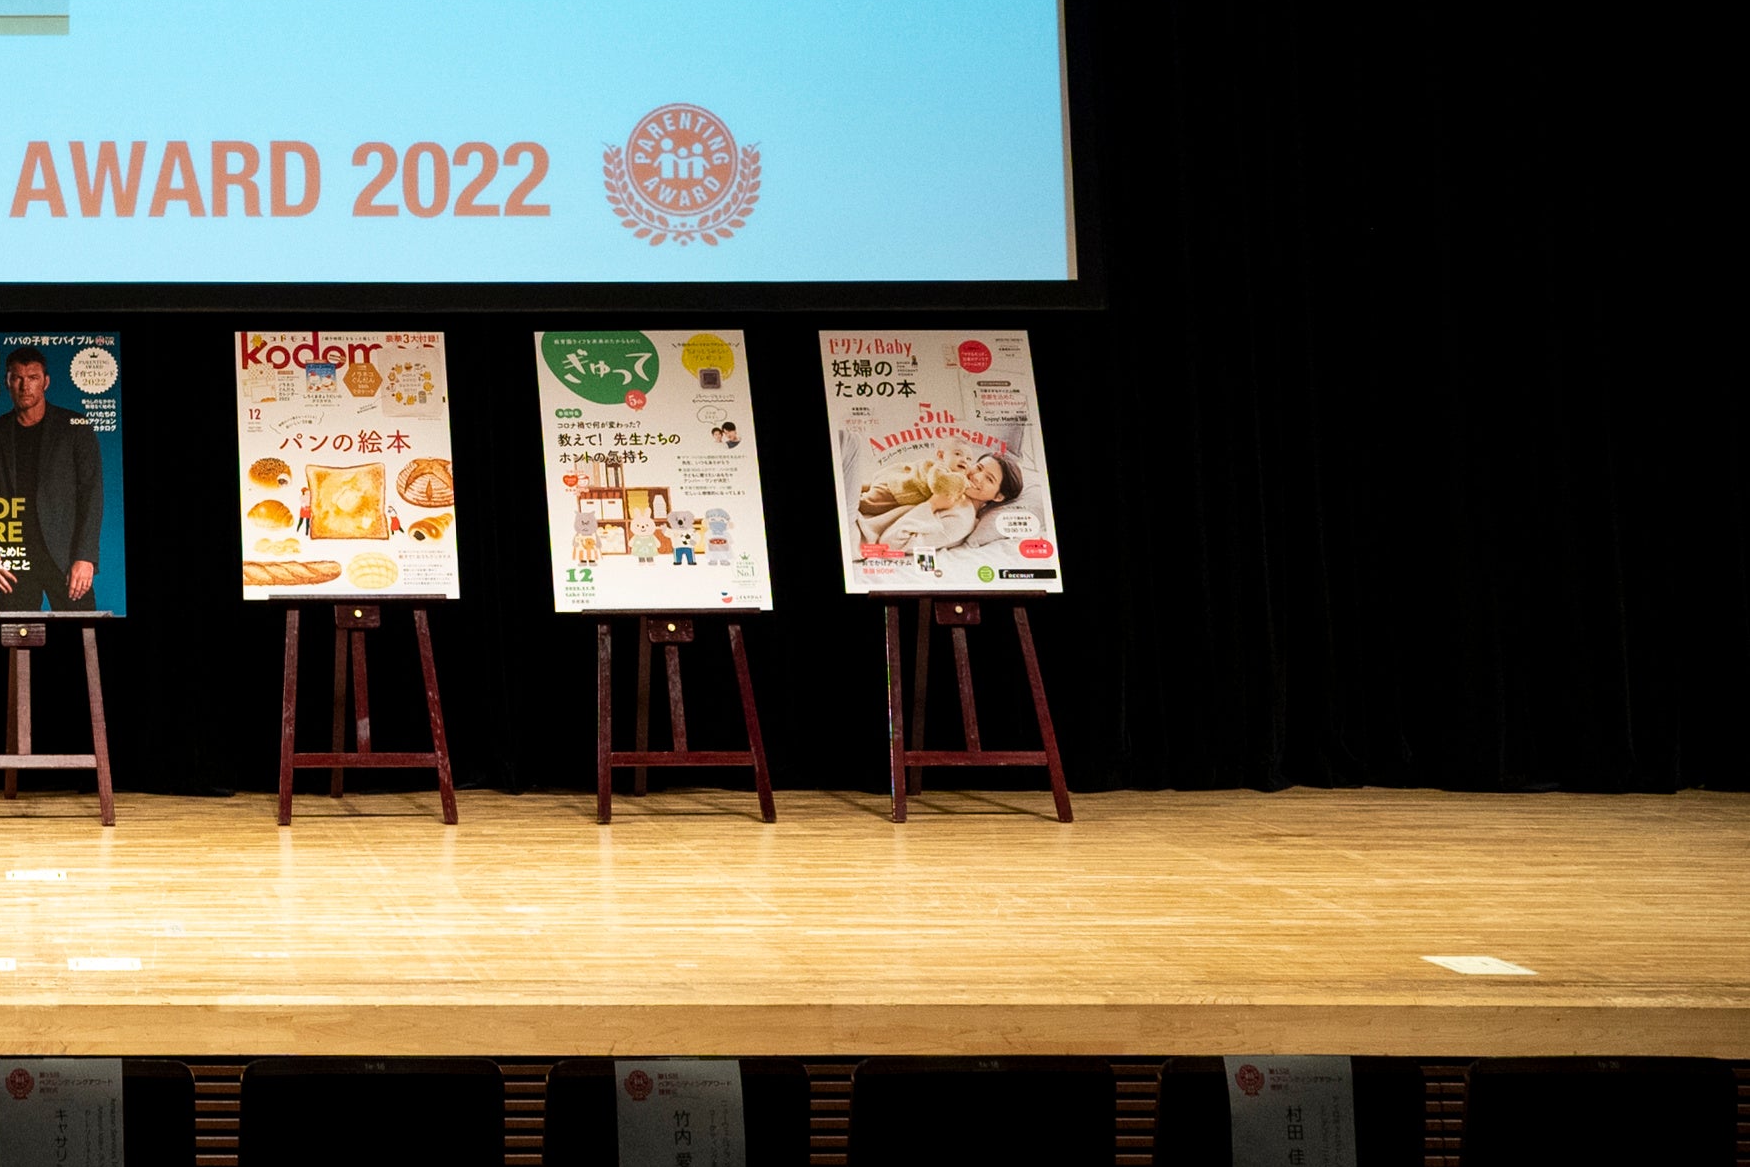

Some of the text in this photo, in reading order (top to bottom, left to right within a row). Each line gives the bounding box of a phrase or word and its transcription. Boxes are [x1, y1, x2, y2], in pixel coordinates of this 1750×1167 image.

[634, 112, 730, 165] PARENTING
[10, 141, 323, 220] AWARD
[351, 141, 551, 220] 2022
[643, 176, 721, 207] AWARD
[241, 332, 435, 370] kodom
[562, 348, 652, 385] ぎゅって
[832, 359, 892, 378] 妊婦の
[835, 380, 917, 398] ための本
[249, 408, 261, 420] 12
[919, 402, 955, 424] 5th
[279, 429, 412, 454] パンの絵本
[613, 433, 681, 446] 先生たちの
[869, 422, 1007, 456] Anniversary
[559, 450, 649, 464] ホントの気持ち
[565, 568, 594, 583] 12
